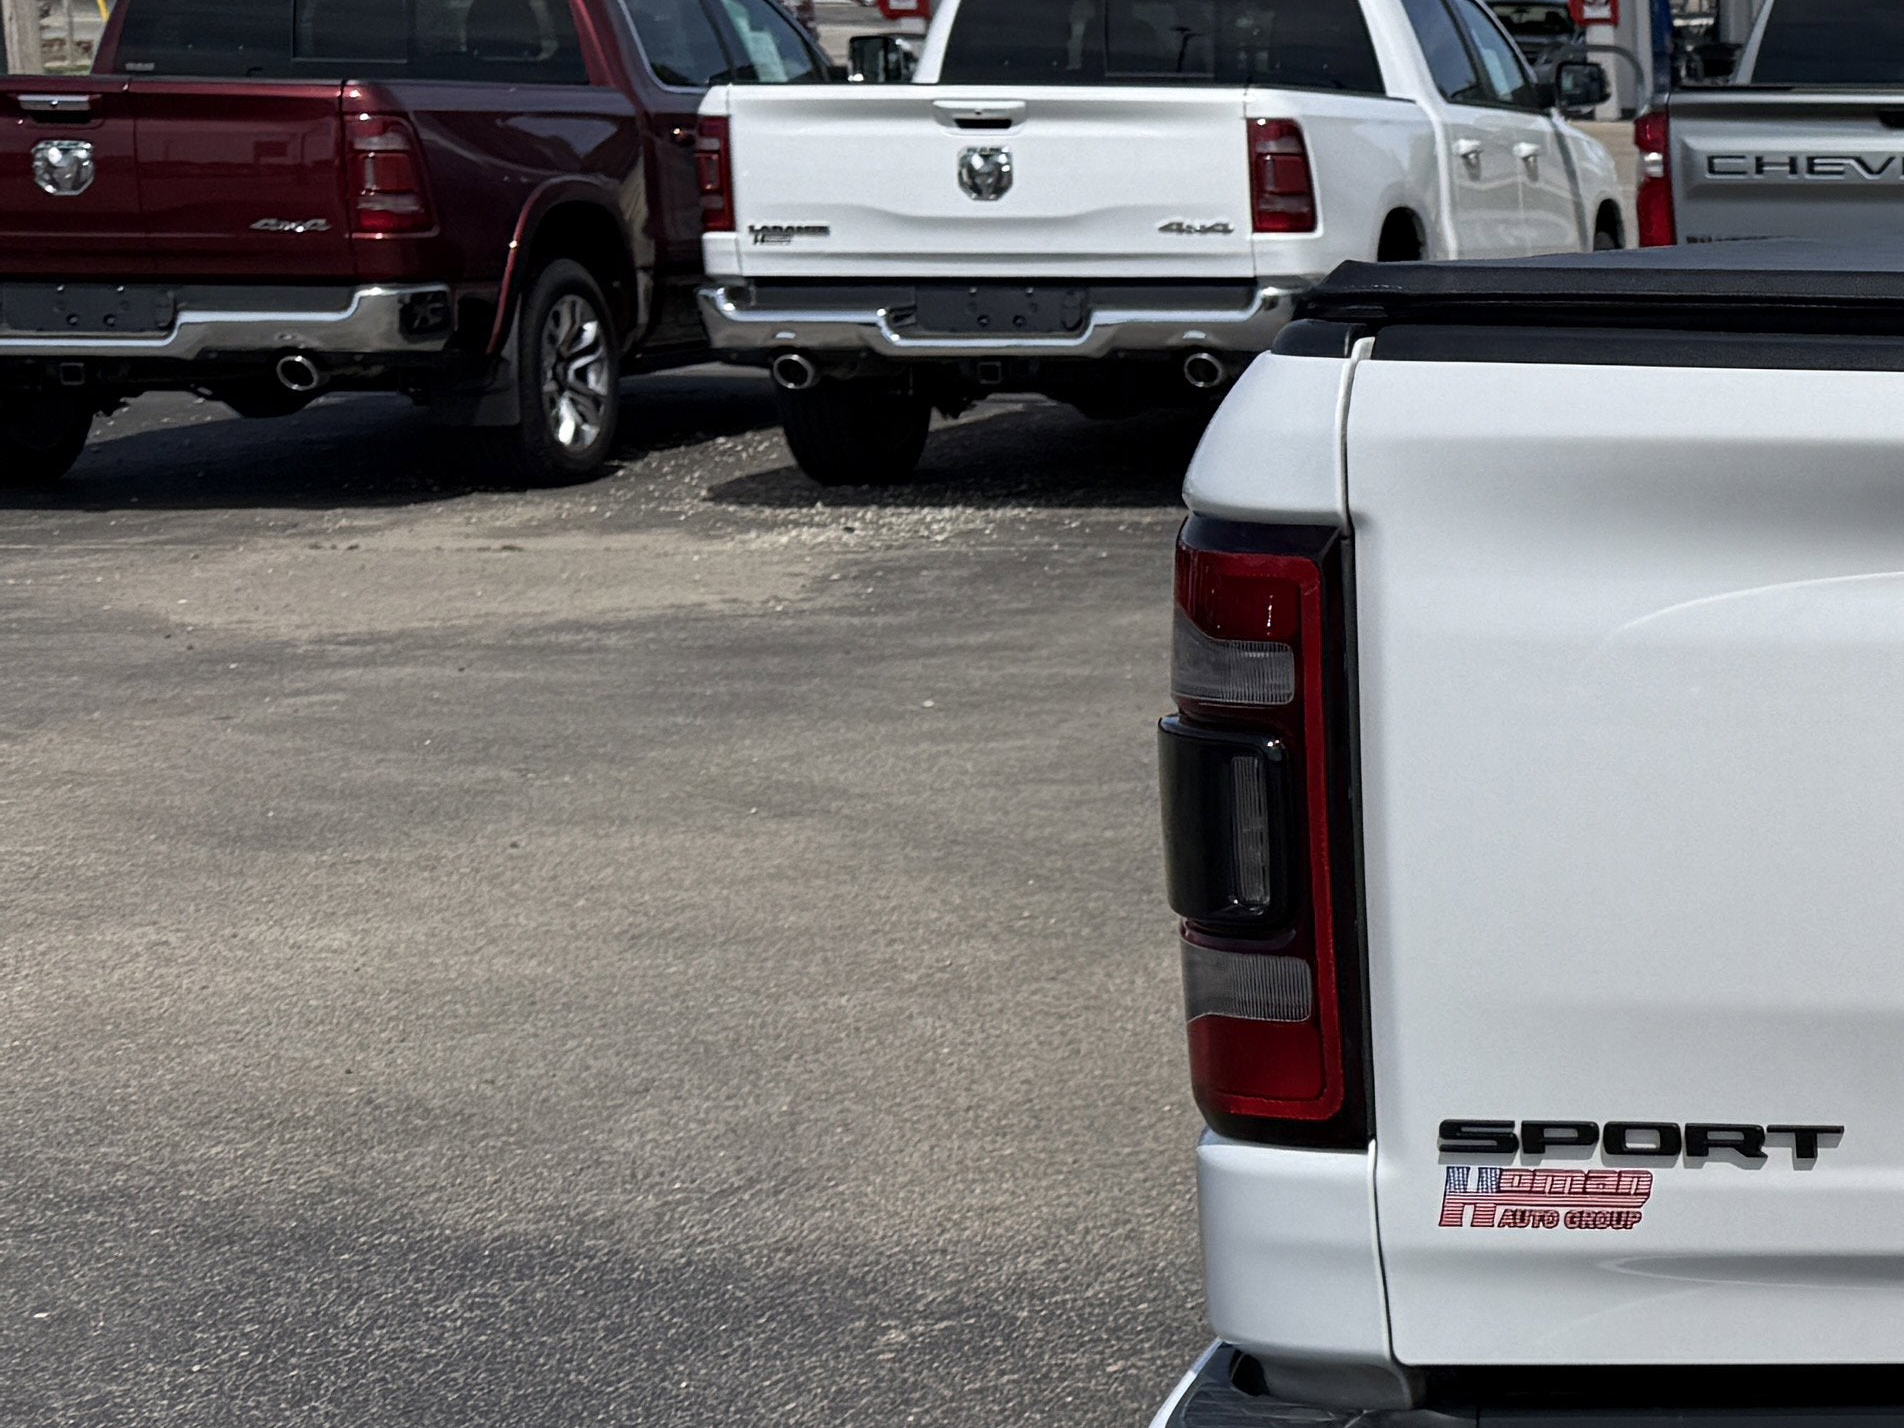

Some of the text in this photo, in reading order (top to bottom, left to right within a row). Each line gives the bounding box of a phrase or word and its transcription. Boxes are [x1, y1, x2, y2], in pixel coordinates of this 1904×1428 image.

[1438, 1118, 1845, 1160] SPORT
[1498, 1208, 1643, 1230] AUTO GROUP
